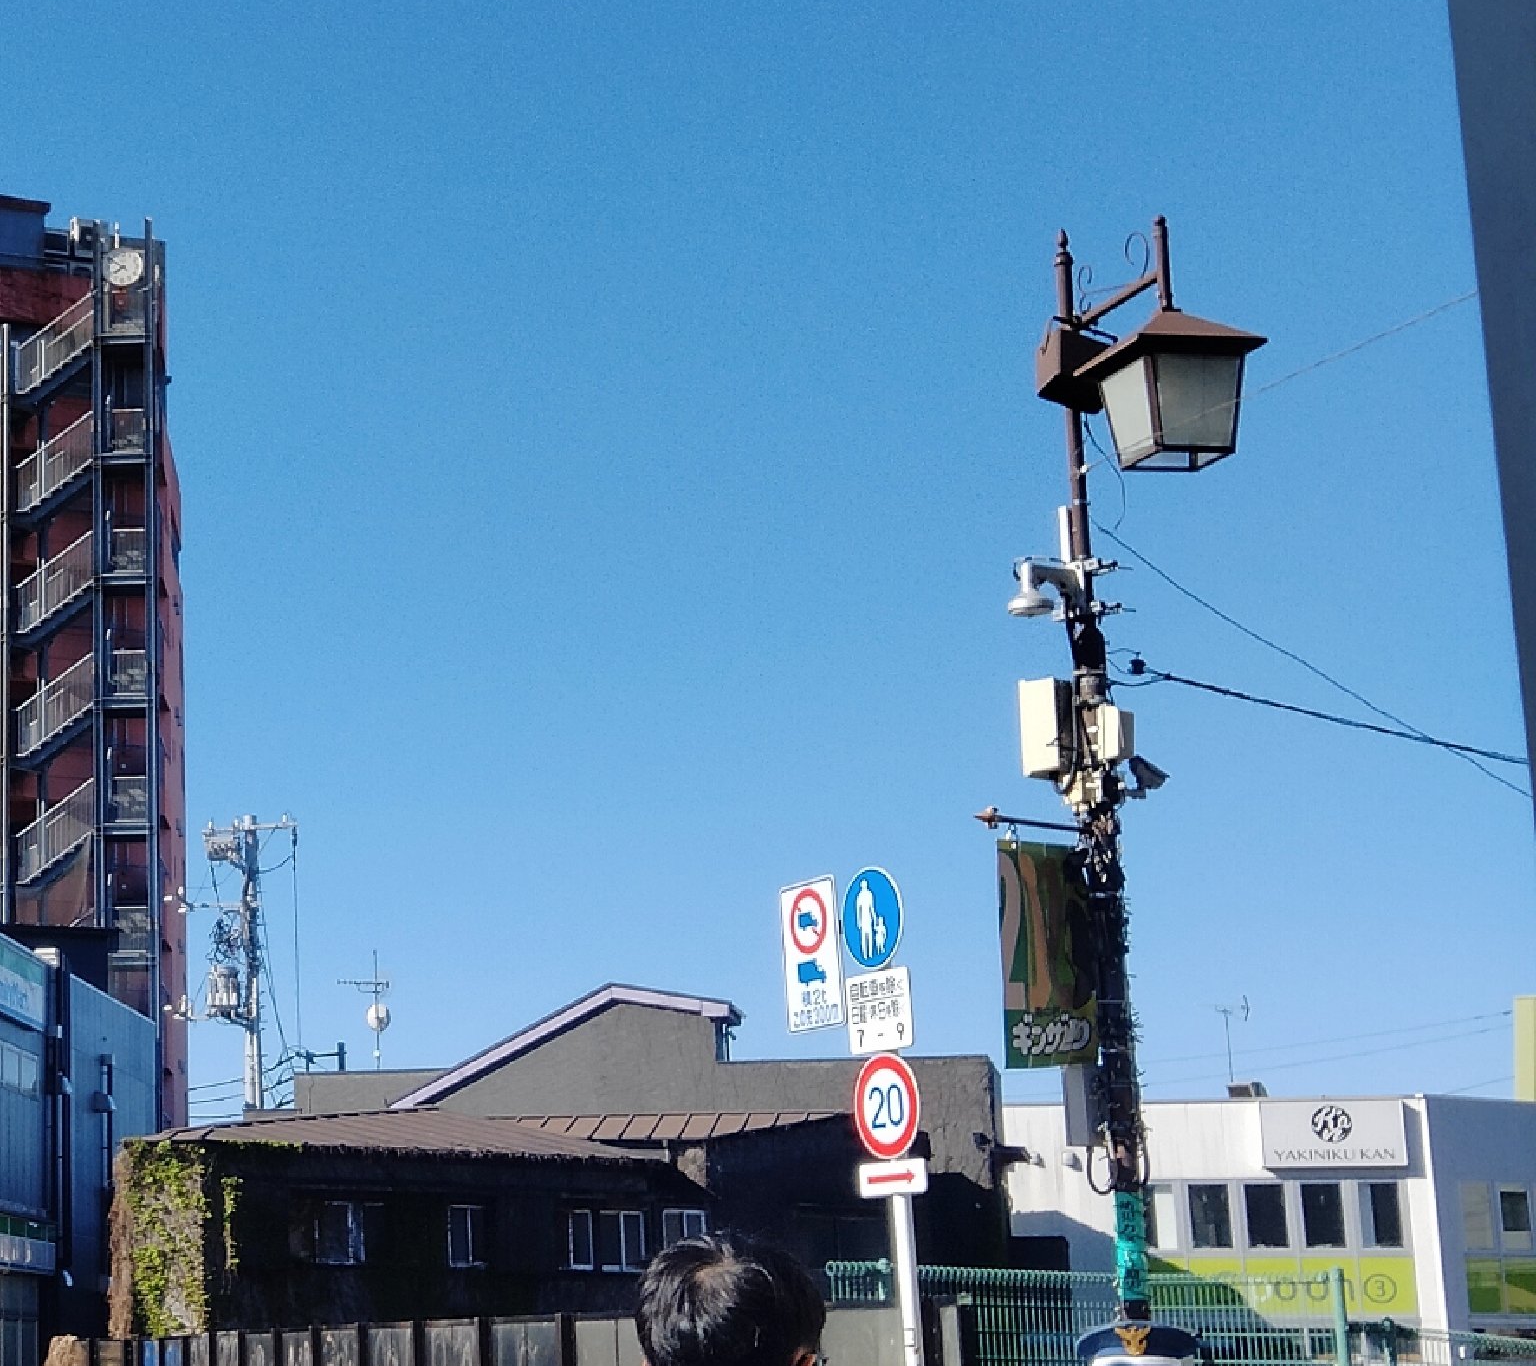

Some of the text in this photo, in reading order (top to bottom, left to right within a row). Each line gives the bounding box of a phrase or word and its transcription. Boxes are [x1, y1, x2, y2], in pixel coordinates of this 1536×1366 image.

[868, 1083, 905, 1130] 20
[1273, 1146, 1396, 1162] YAKINIKU KAN
